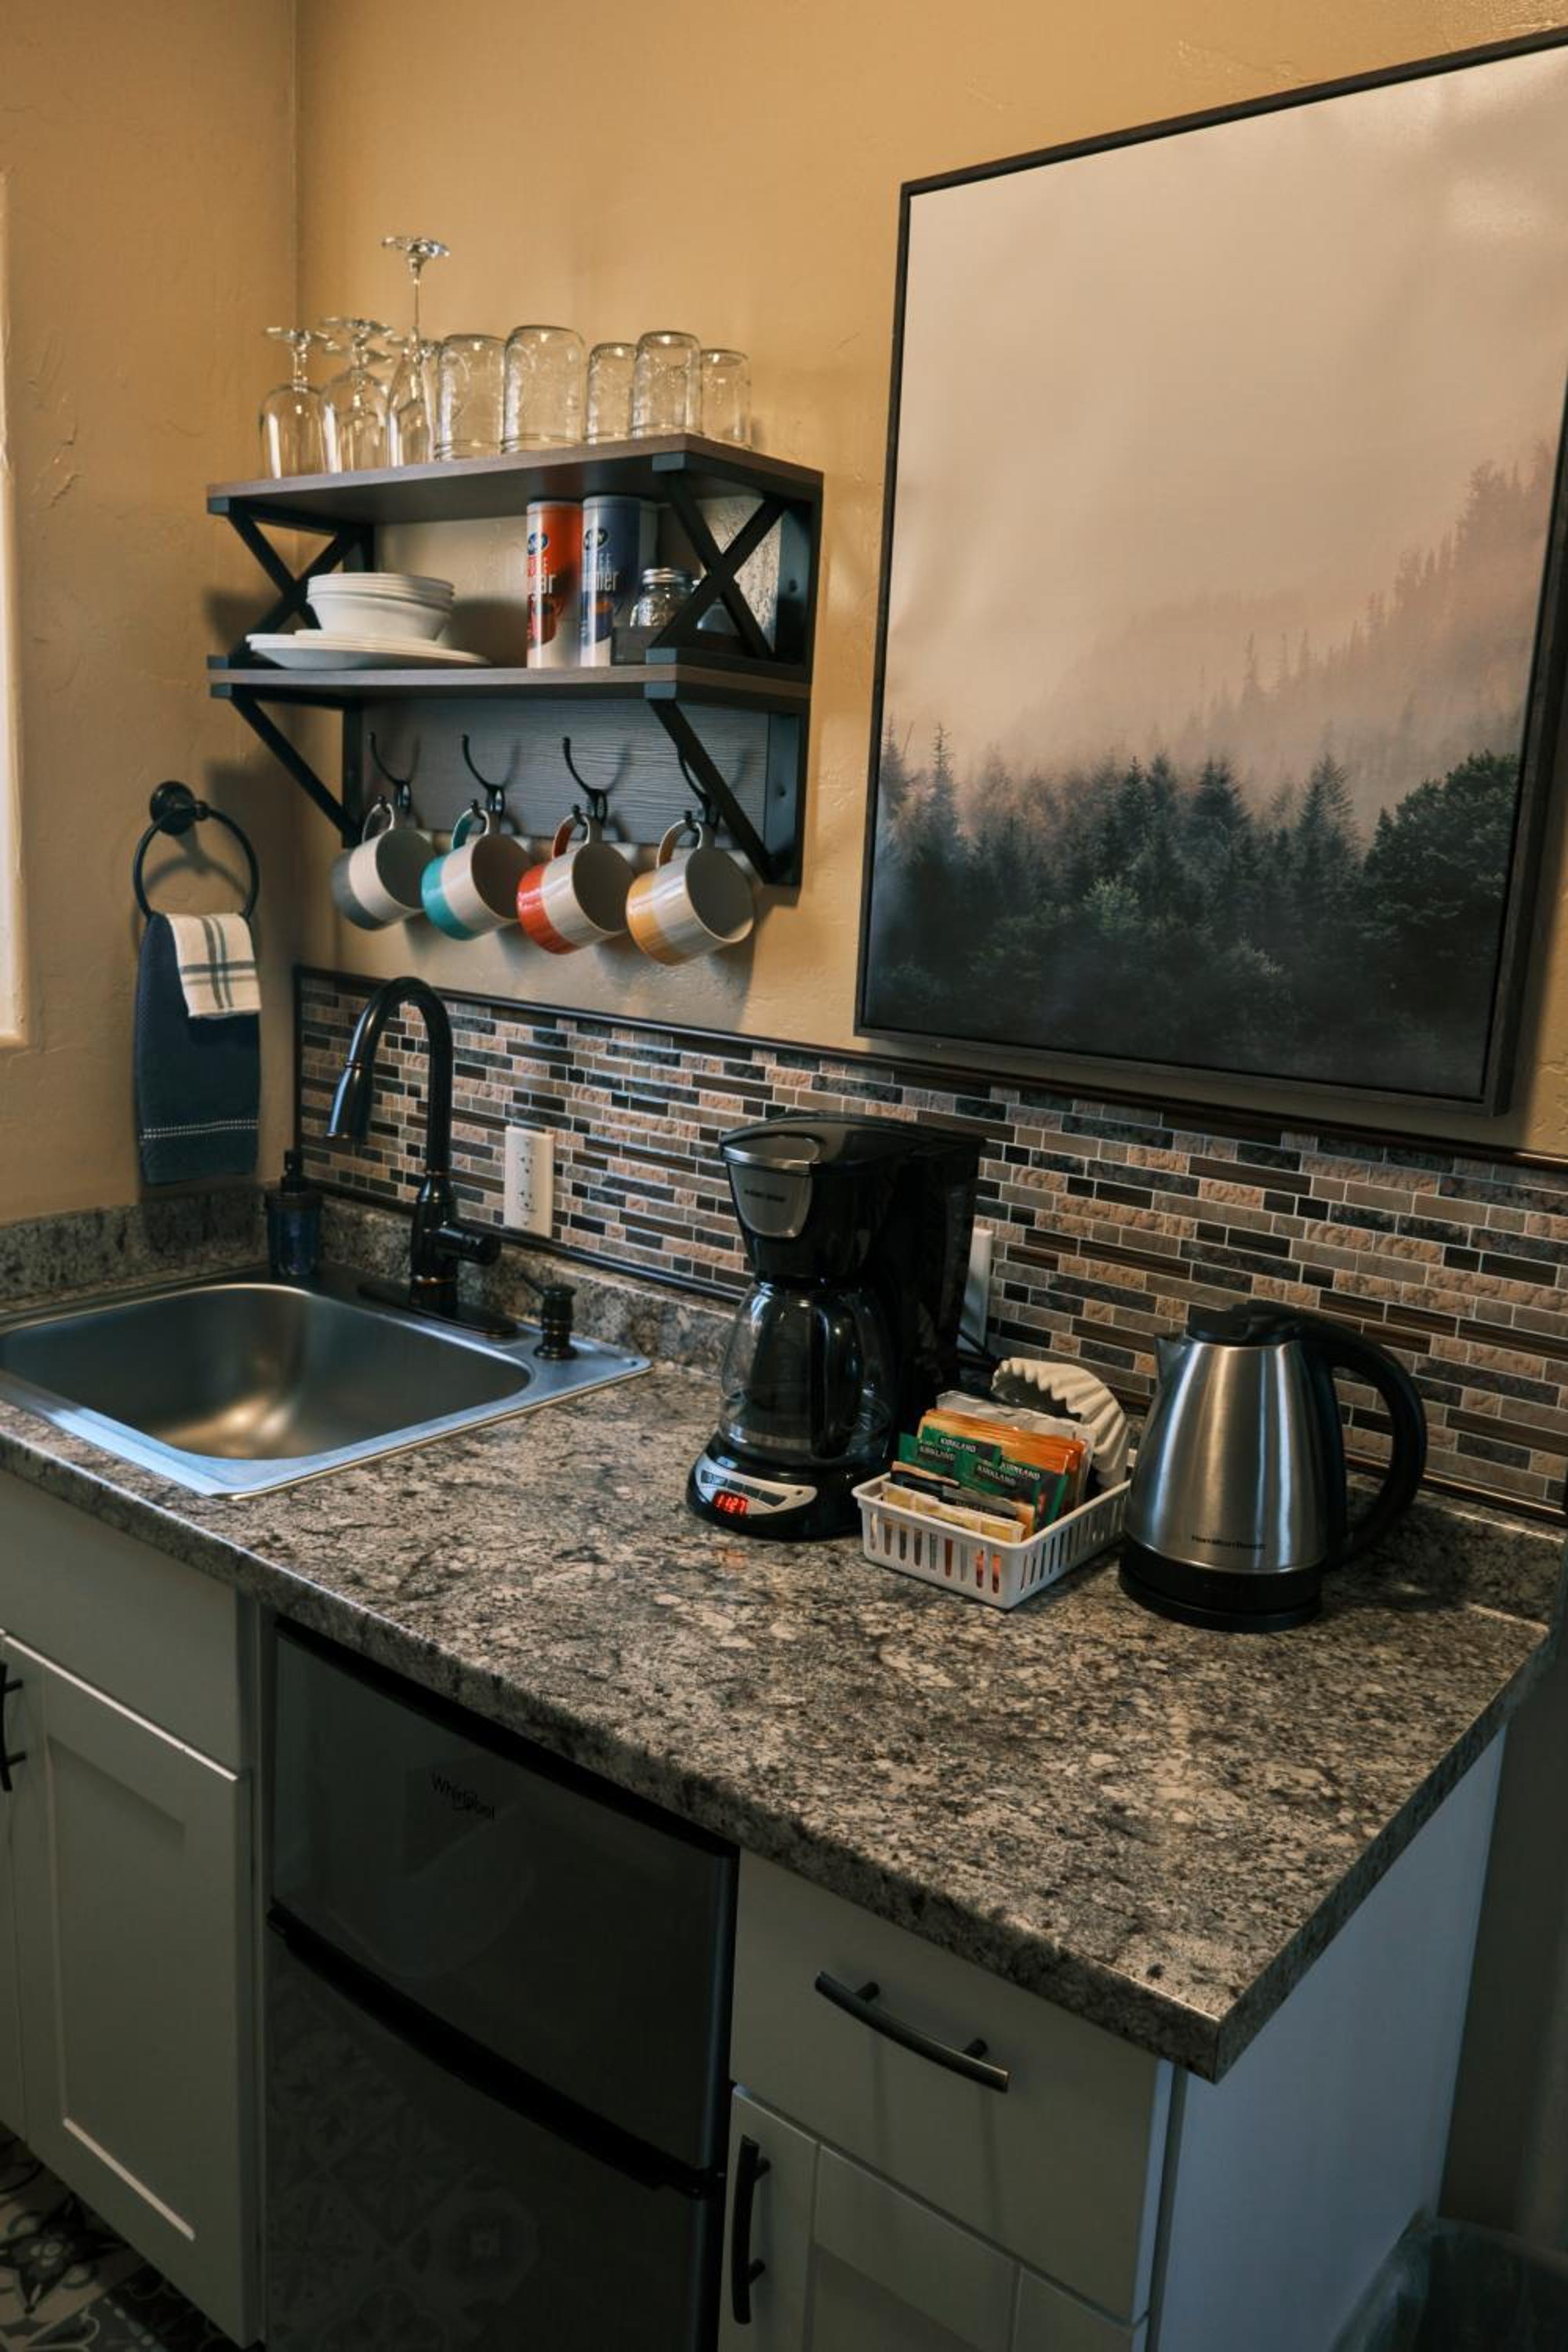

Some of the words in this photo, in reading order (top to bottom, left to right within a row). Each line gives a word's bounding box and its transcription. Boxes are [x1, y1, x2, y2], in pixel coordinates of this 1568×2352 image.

[919, 1445, 956, 1461] KIRKLAND
[940, 1437, 977, 1453] KIRKLAND
[431, 1772, 495, 1820] Whirlpool
